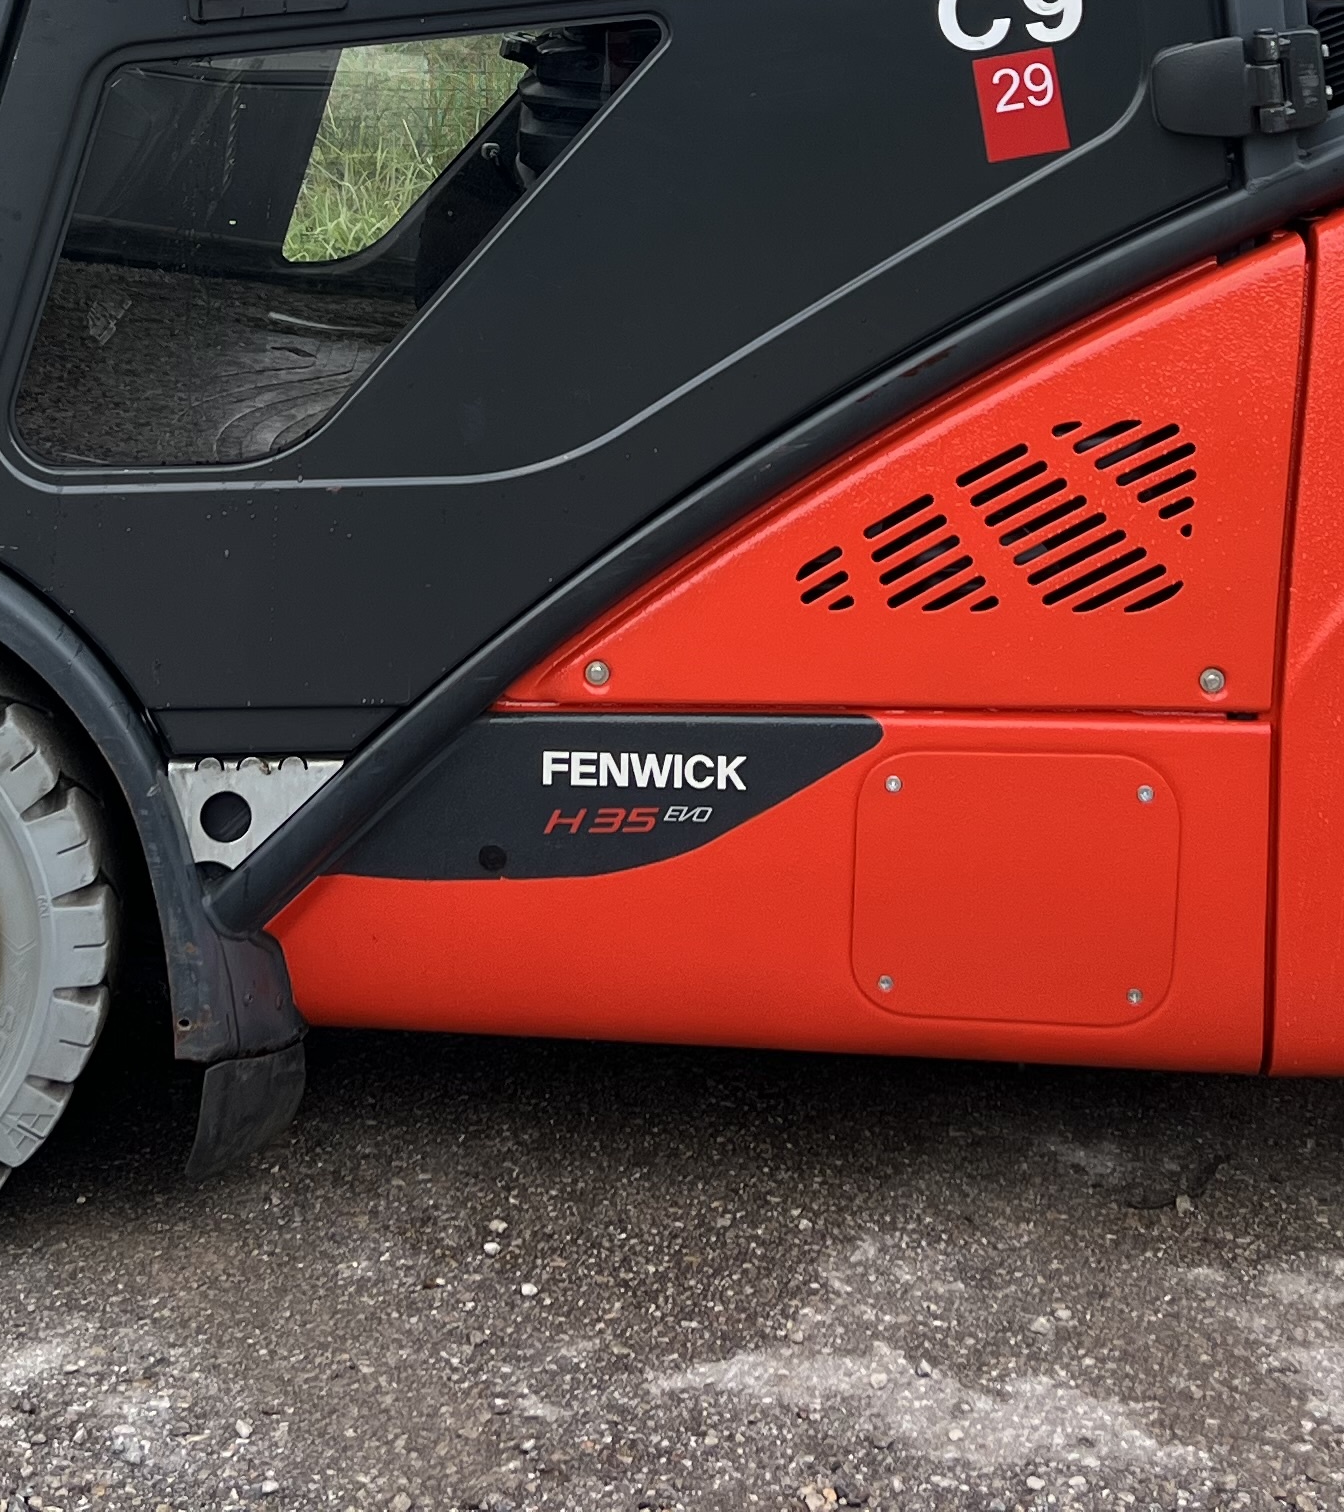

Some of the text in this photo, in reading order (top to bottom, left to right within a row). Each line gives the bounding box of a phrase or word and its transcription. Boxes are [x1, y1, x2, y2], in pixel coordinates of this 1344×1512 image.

[992, 62, 1054, 113] 29
[542, 750, 747, 791] FENWICK
[663, 805, 713, 823] EVO
